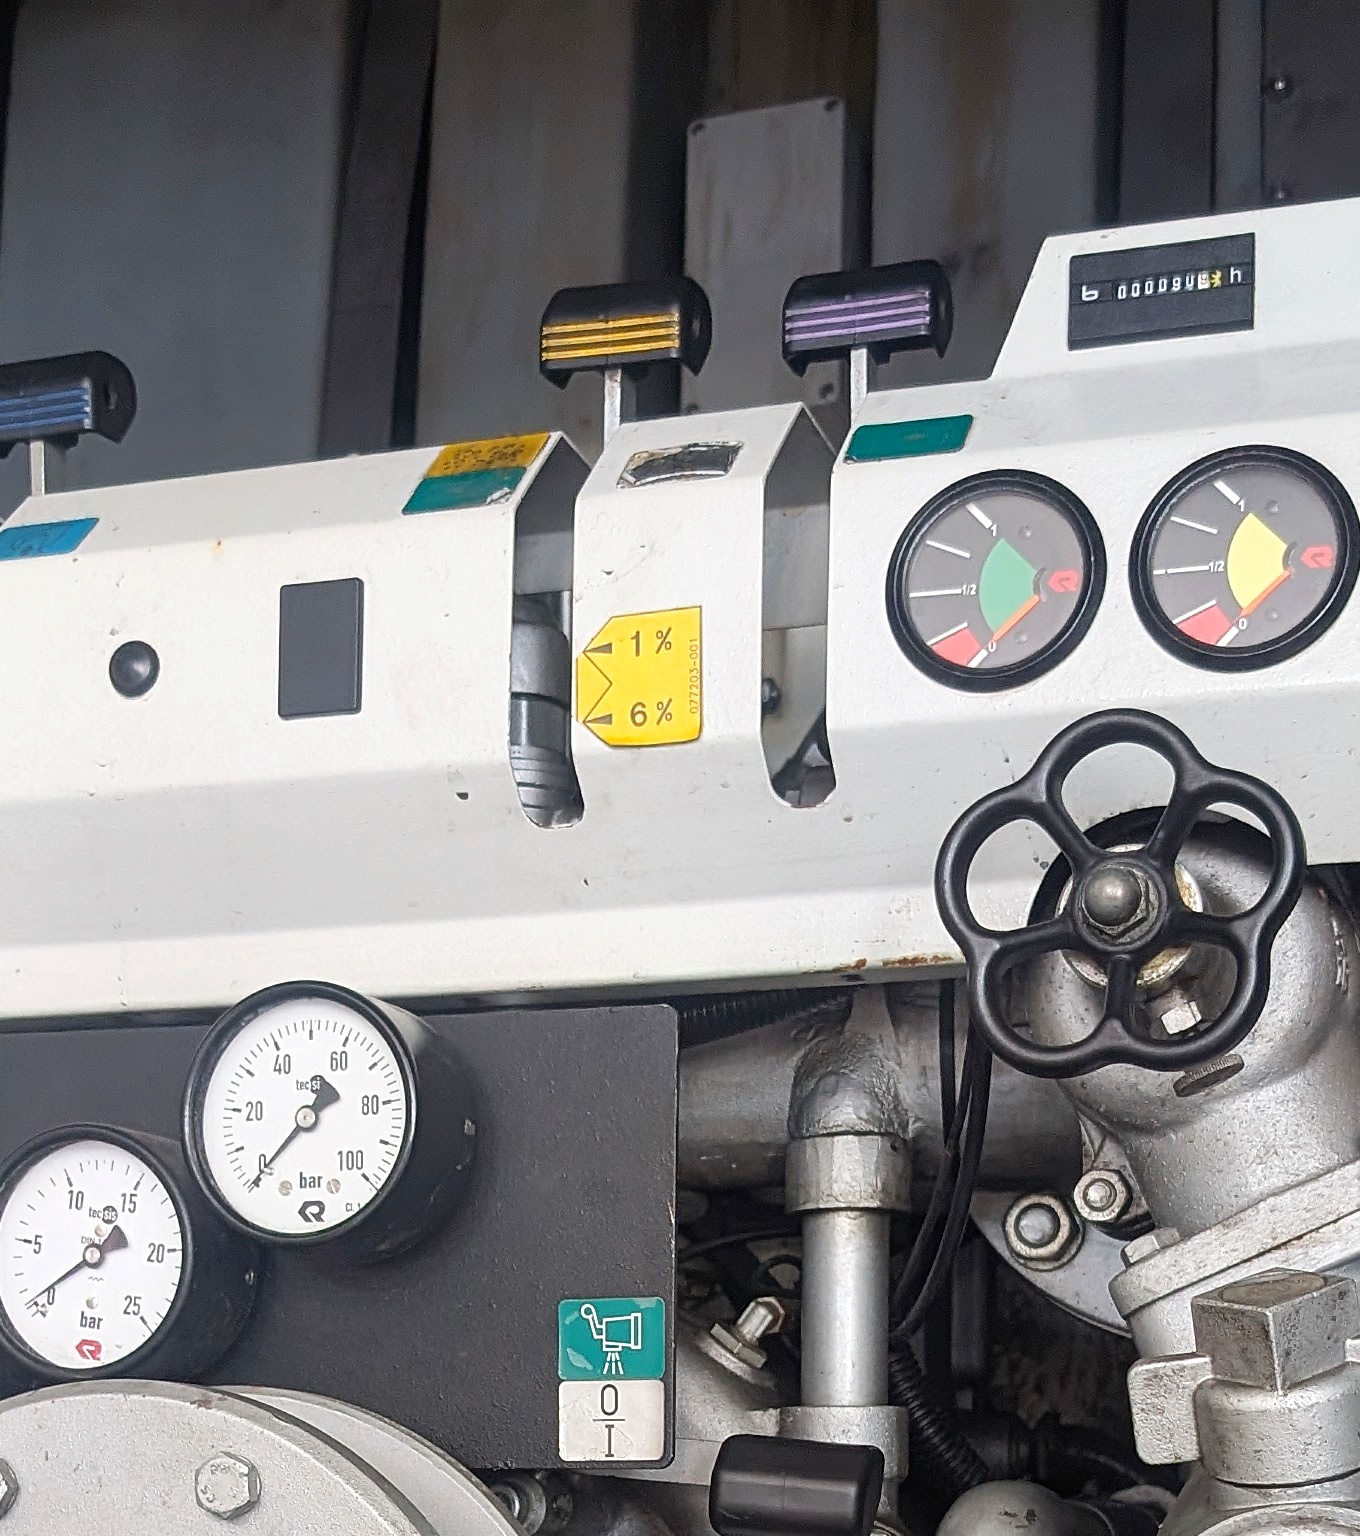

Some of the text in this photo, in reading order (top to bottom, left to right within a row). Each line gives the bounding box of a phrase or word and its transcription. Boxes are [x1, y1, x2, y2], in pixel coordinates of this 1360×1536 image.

[1229, 266, 1243, 284] h
[1208, 560, 1225, 573] 1/2
[961, 584, 977, 596] 1/2
[1238, 617, 1248, 630] 0
[629, 626, 673, 657] 1 %
[689, 638, 700, 714] 077203-001
[629, 697, 673, 728] 6 %
[273, 1053, 292, 1075] 40
[330, 1050, 348, 1072] 60
[295, 1076, 322, 1093] tecsi
[245, 1100, 264, 1122] 20
[361, 1094, 380, 1116] 80
[258, 1153, 267, 1174] 0
[338, 1149, 364, 1171] 100
[299, 1171, 324, 1189] bar
[67, 1189, 84, 1211] 10
[120, 1192, 138, 1214] 15
[33, 1234, 43, 1255] 5
[146, 1242, 165, 1263] 20
[46, 1286, 55, 1306] 0
[123, 1294, 142, 1317] 25
[79, 1310, 104, 1330] bar
[600, 1383, 619, 1416] 0
